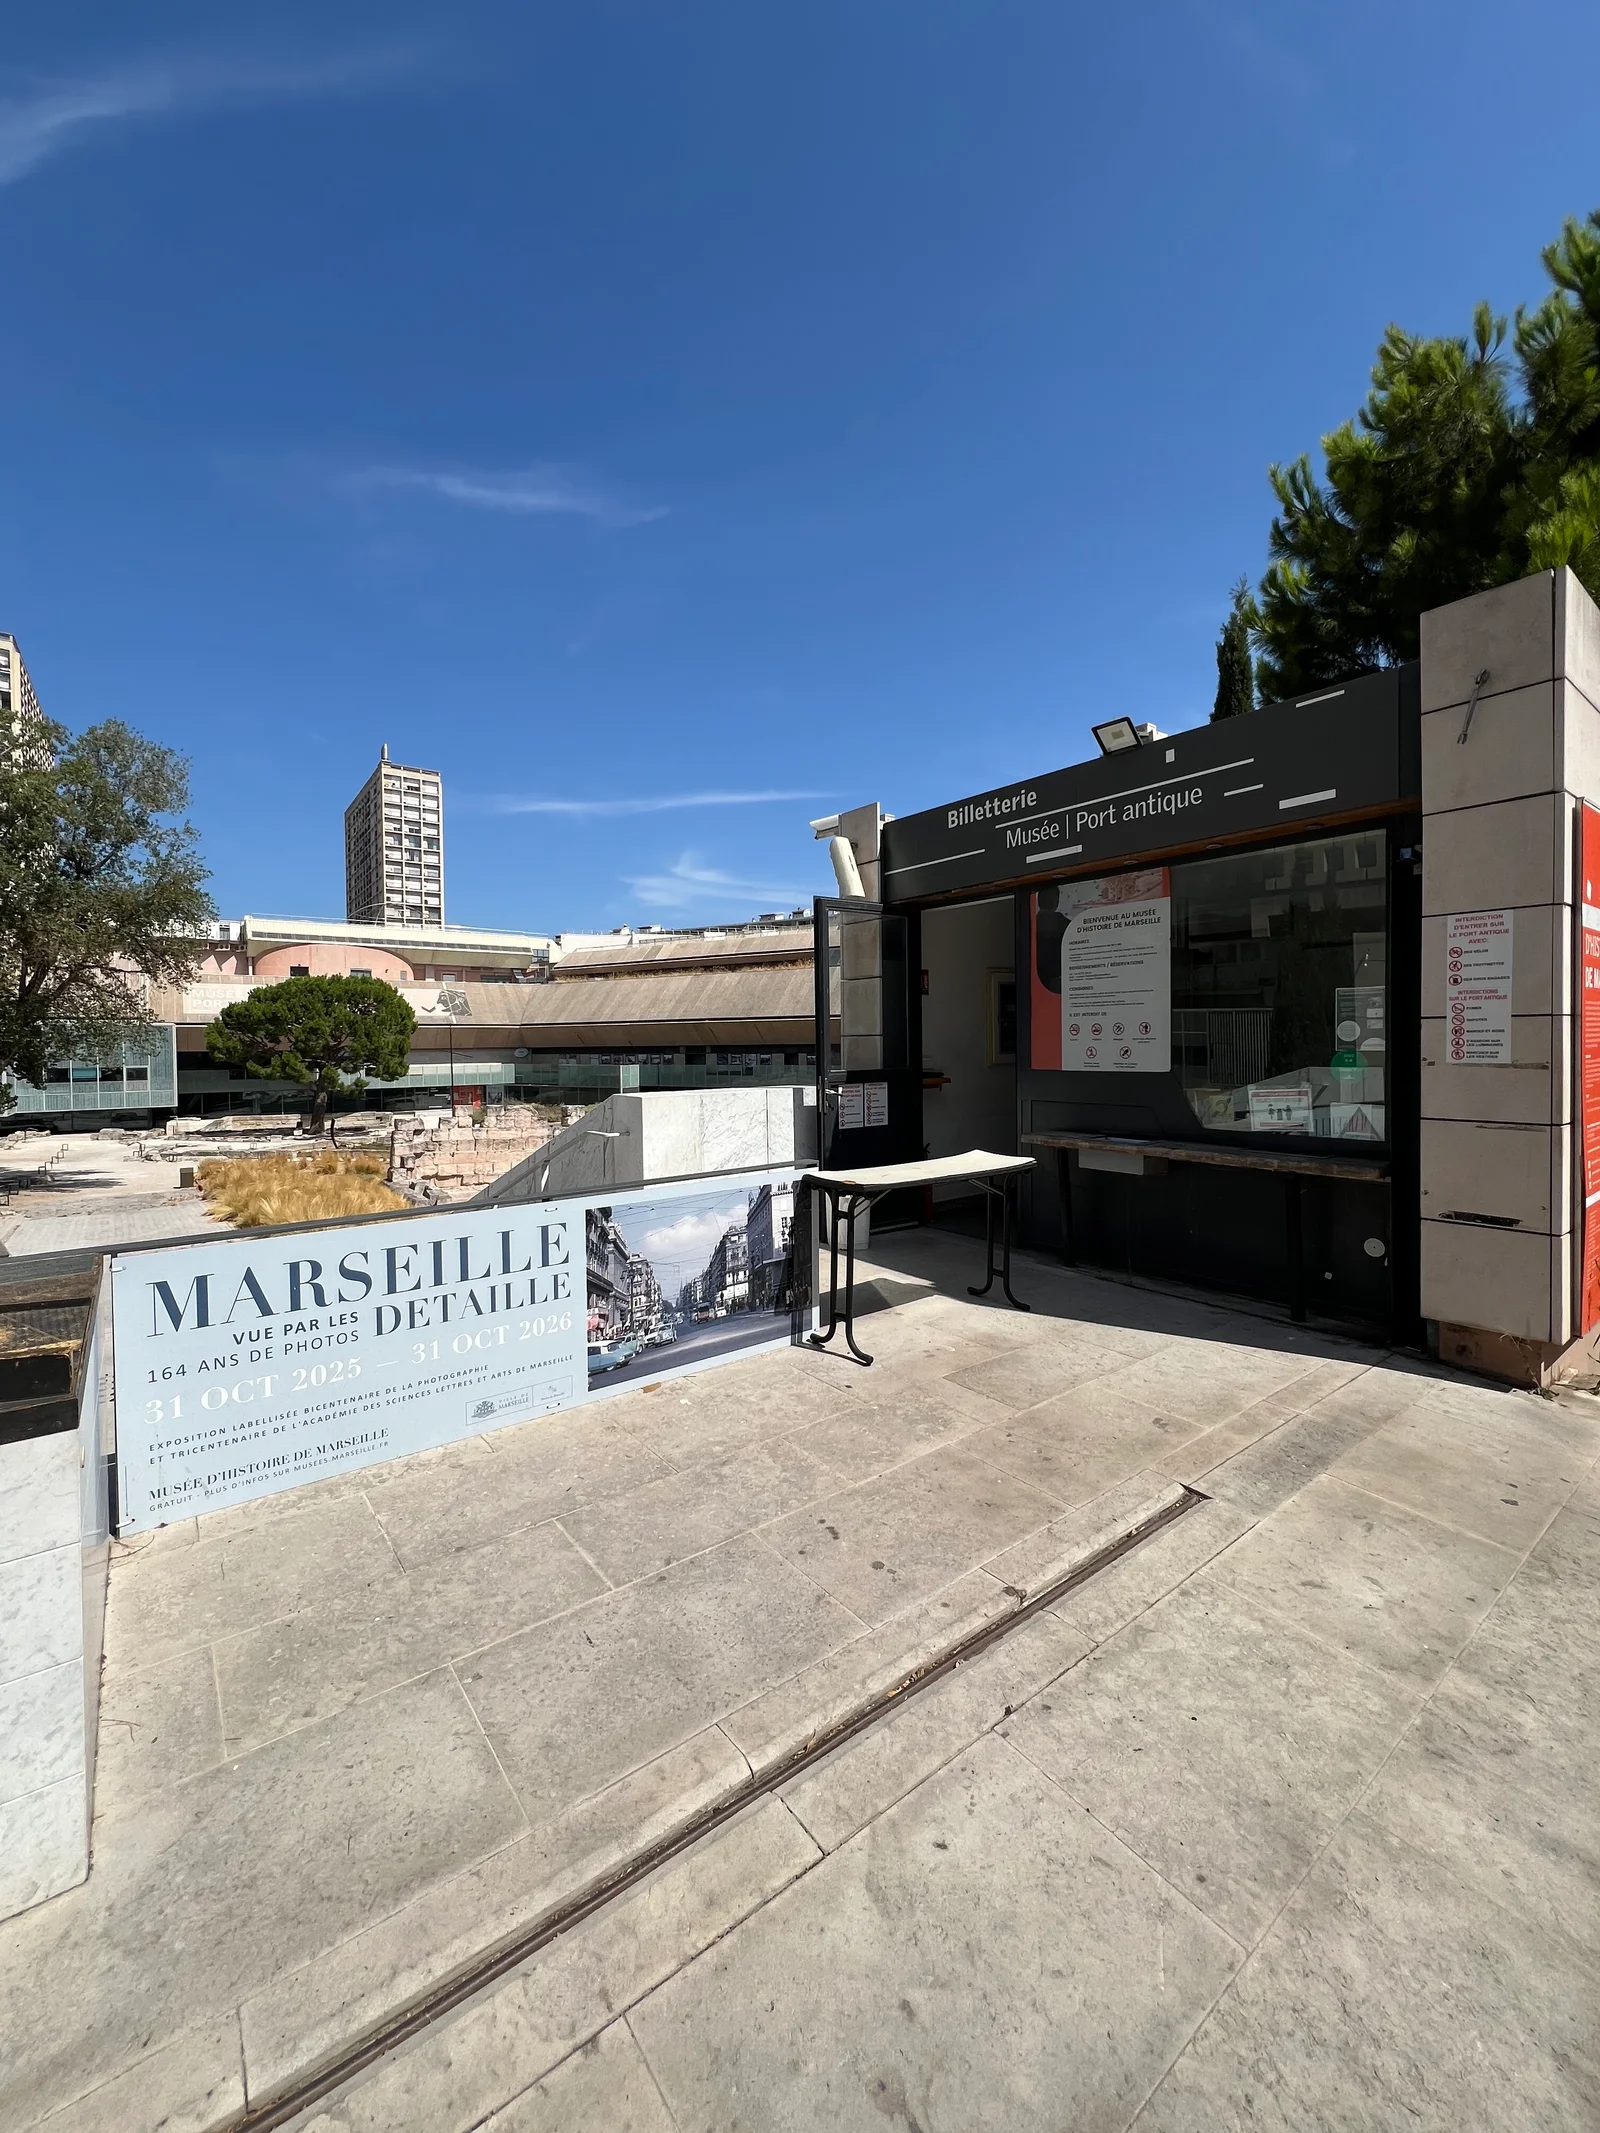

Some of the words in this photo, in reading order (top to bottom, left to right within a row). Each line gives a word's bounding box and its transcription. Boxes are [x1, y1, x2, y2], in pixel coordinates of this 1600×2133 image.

[947, 789, 1037, 829] Billetterie
[1006, 820, 1060, 849] Musée
[1076, 804, 1117, 832] Port
[1122, 787, 1203, 822] antique
[1076, 923, 1112, 933] D'HISTOIRE
[1124, 916, 1161, 928] MARSEILLE
[1082, 913, 1119, 925] BIENVENUE
[1132, 908, 1156, 918] MUSÉE
[1454, 922, 1488, 931] D'ENTRER
[1455, 913, 1504, 923] INTERDICTION
[1478, 928, 1510, 936] ANTIQUE
[1585, 966, 1593, 988] DE
[146, 1222, 570, 1338] MARSEILLE
[373, 1272, 572, 1337] DETAILLE
[232, 1327, 274, 1345] VUE
[283, 1319, 320, 1336] PAR
[329, 1311, 359, 1327] LES
[144, 1394, 185, 1424] 31
[200, 1373, 280, 1411] OCT
[291, 1356, 362, 1391] 2025
[411, 1340, 441, 1364] 31
[452, 1324, 511, 1355] OCT
[518, 1311, 573, 1341] 2026
[148, 1363, 187, 1384] 164
[198, 1353, 240, 1374] ANS
[250, 1346, 274, 1363] DE
[284, 1330, 359, 1356] PHOTOS
[149, 1427, 227, 1452] EXPOSITION
[232, 1410, 298, 1431] LABELLISÉE
[304, 1390, 381, 1414] BICENTENAIRE
[385, 1386, 398, 1395] DE
[418, 1364, 489, 1386] PHOTOGRAPHIE
[149, 1455, 164, 1465] ET
[170, 1430, 267, 1460] TRICENTENAIRE
[273, 1425, 286, 1434] DE
[292, 1407, 358, 1429] L'ACADÉMIE
[363, 1401, 381, 1411] DES
[386, 1390, 432, 1406] SCIENCES
[435, 1380, 473, 1393] LETTRES
[477, 1375, 487, 1383] ET
[491, 1369, 512, 1380] ARTS
[516, 1365, 526, 1374] DE
[530, 1354, 574, 1369] MARSEILLE
[498, 1396, 529, 1410] MARSEILLE
[149, 1476, 203, 1500] MUSÉE
[207, 1453, 290, 1485] D'HISTOIRE
[294, 1448, 313, 1462] DE
[316, 1427, 389, 1455] MARSEILLE
[149, 1494, 193, 1512] GRATUIT
[204, 1486, 228, 1497] PLUS
[231, 1474, 269, 1489] D'INFOS
[273, 1468, 290, 1478] SUR
